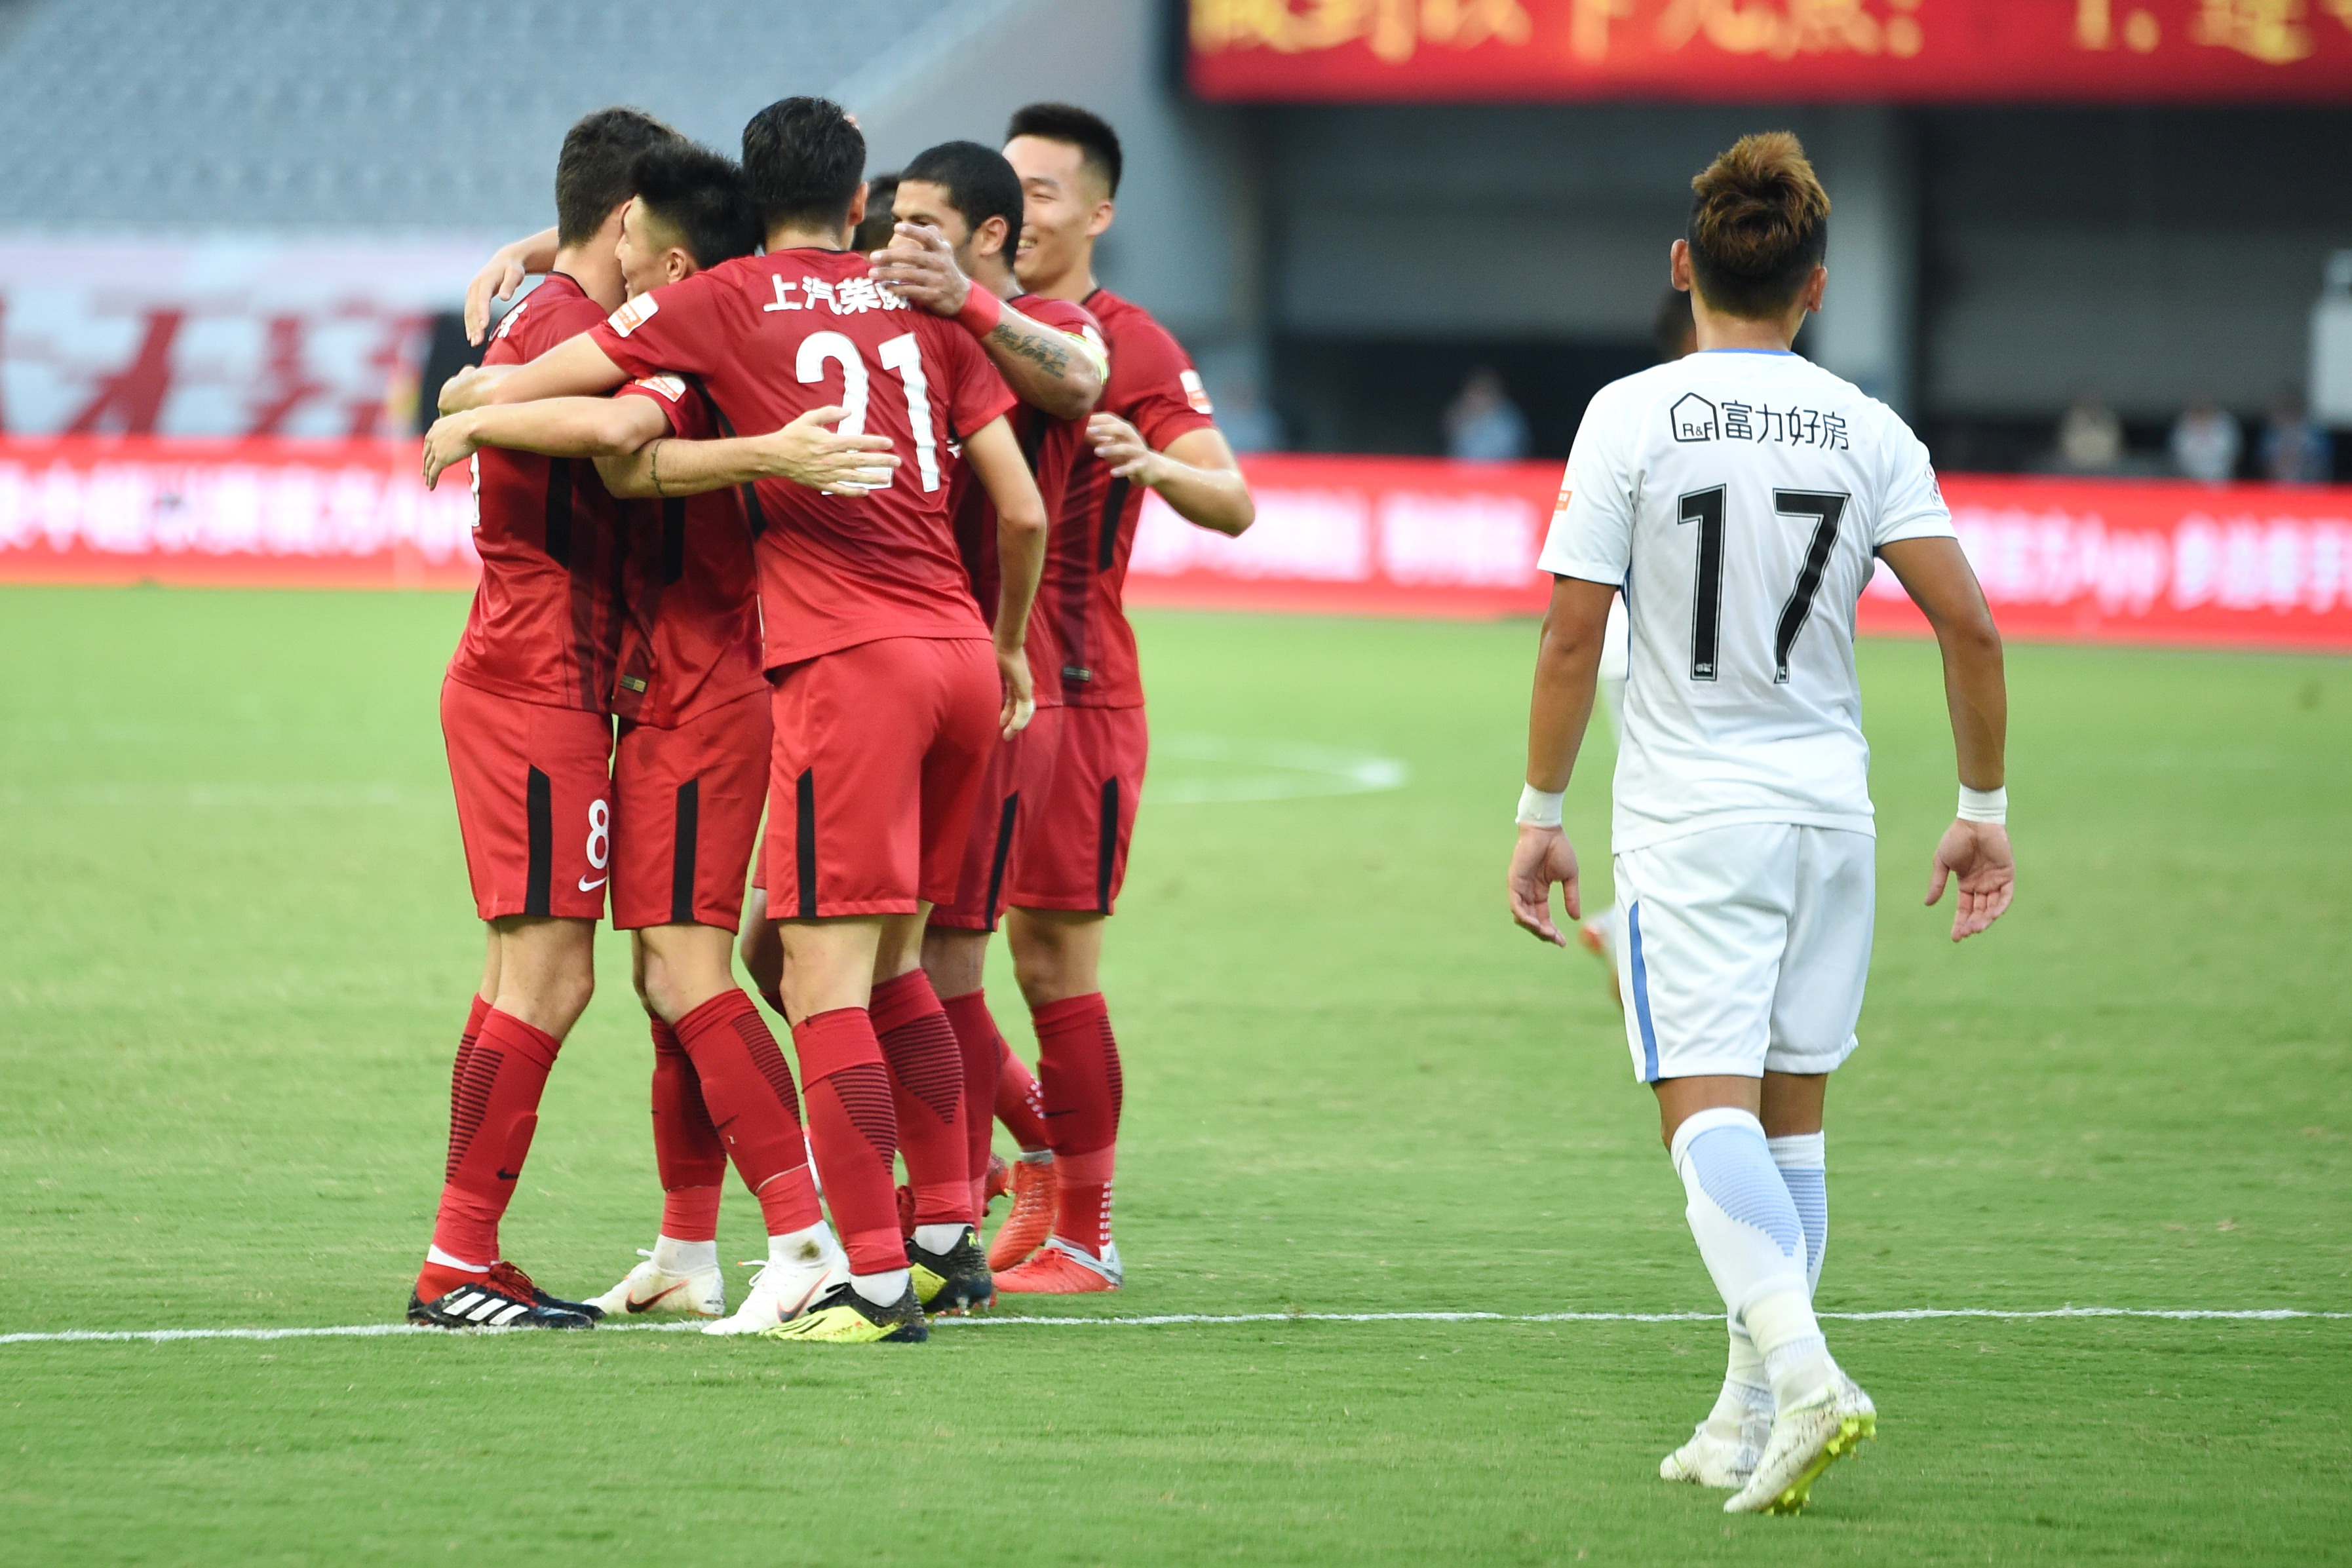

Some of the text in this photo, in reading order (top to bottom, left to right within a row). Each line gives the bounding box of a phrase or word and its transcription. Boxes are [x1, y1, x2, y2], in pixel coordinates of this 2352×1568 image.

[795, 330, 941, 495] 21
[1682, 399, 1850, 451] R&F 富力好房
[1677, 483, 1852, 684] 17
[586, 799, 610, 870] 8
